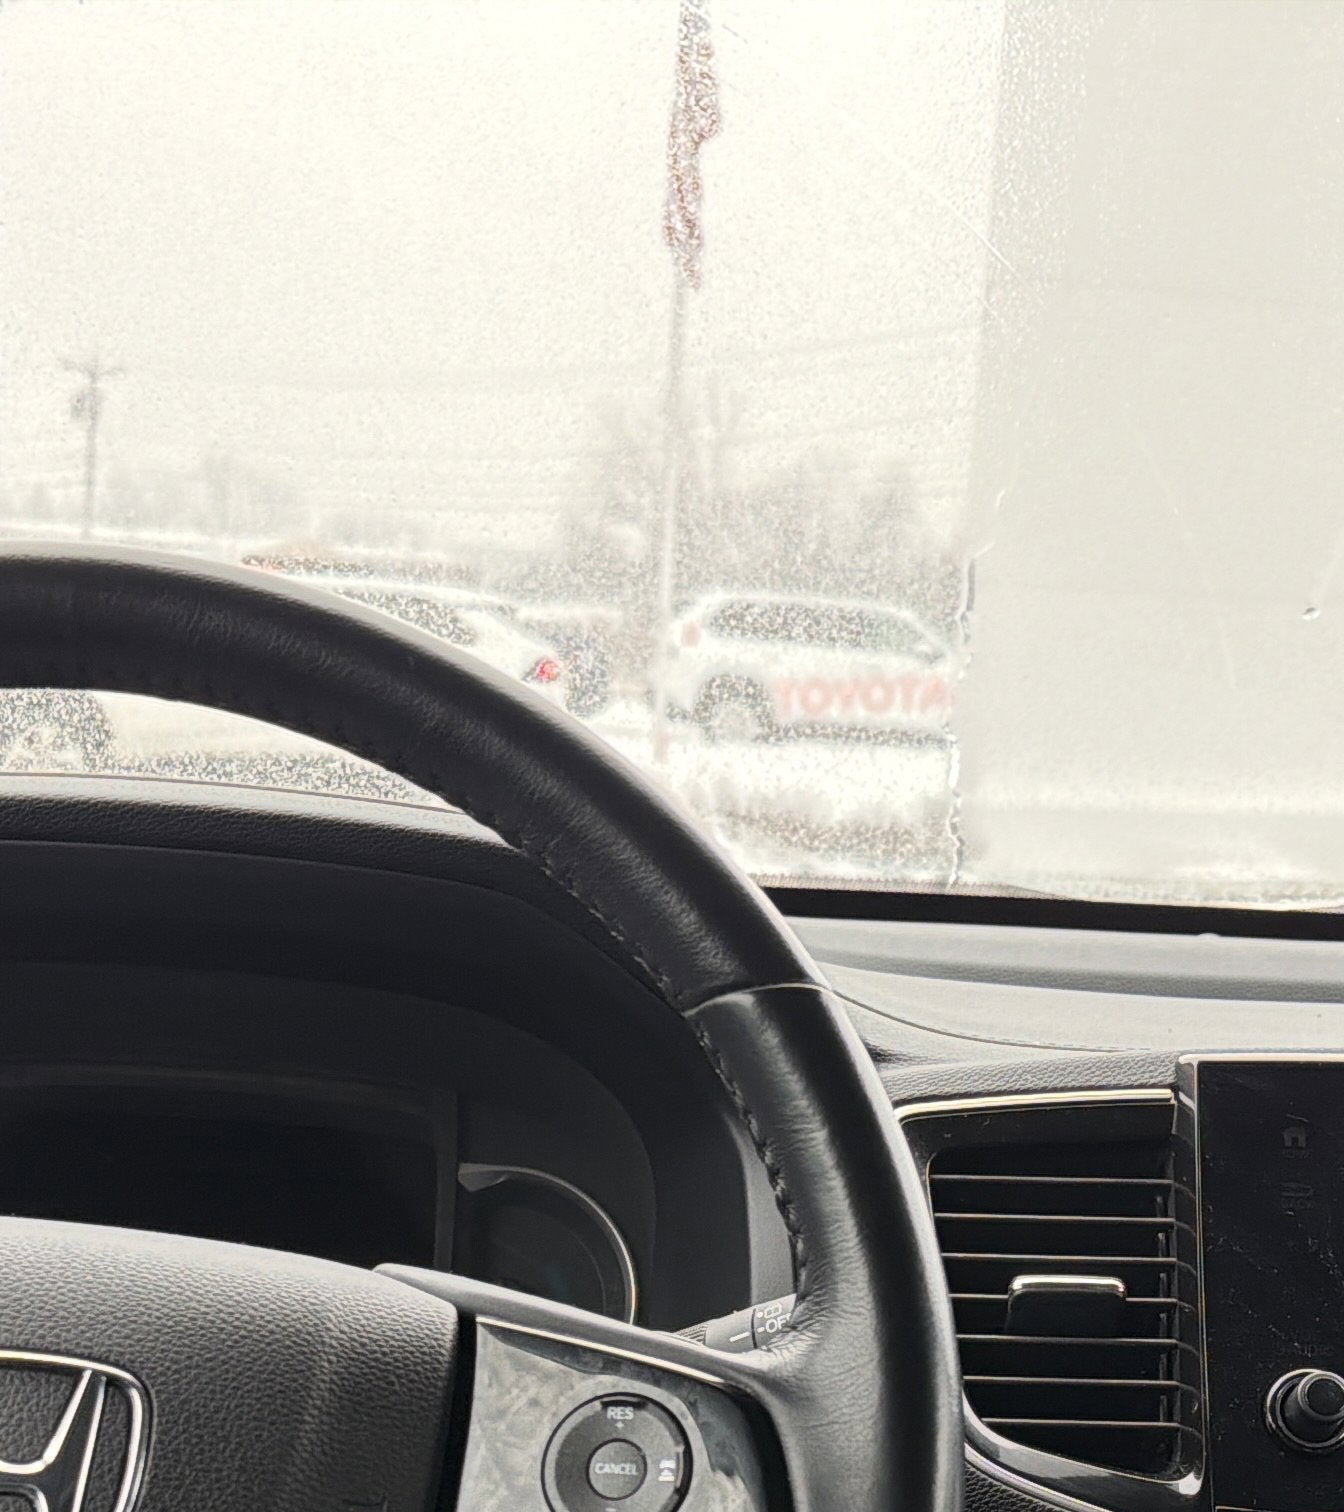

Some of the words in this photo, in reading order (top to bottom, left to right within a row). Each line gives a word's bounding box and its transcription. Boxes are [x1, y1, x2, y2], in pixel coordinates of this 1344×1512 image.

[775, 672, 948, 716] TOYOTA
[607, 1406, 634, 1420] RES
[594, 1462, 639, 1476] CANCEL
